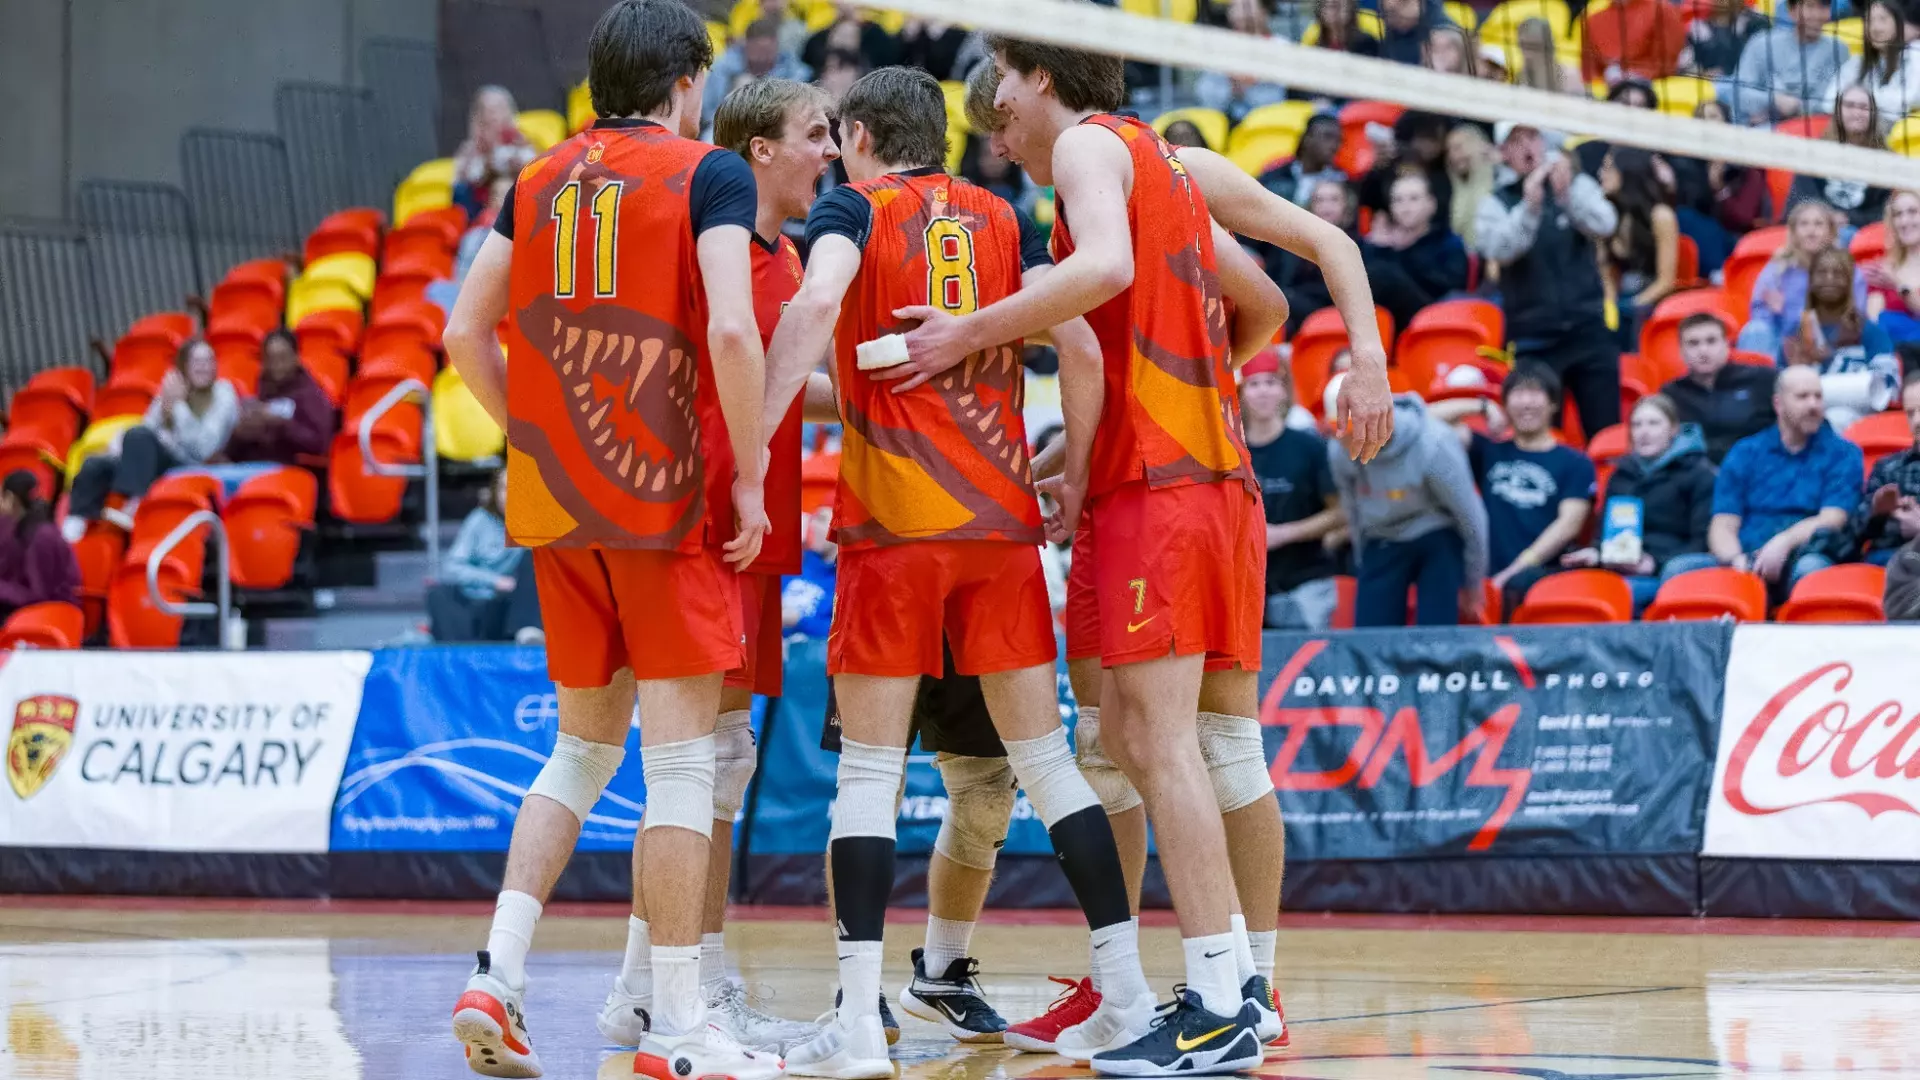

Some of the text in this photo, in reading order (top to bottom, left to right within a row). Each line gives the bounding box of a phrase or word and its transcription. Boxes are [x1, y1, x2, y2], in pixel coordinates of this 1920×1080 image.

[551, 180, 624, 299] 11
[923, 216, 979, 316] 8
[1128, 578, 1147, 614] 7
[1293, 671, 1655, 696] DAVID MOLL PHOTO
[95, 703, 332, 729] UNIVERSITY OF
[81, 740, 324, 786] CALGARY
